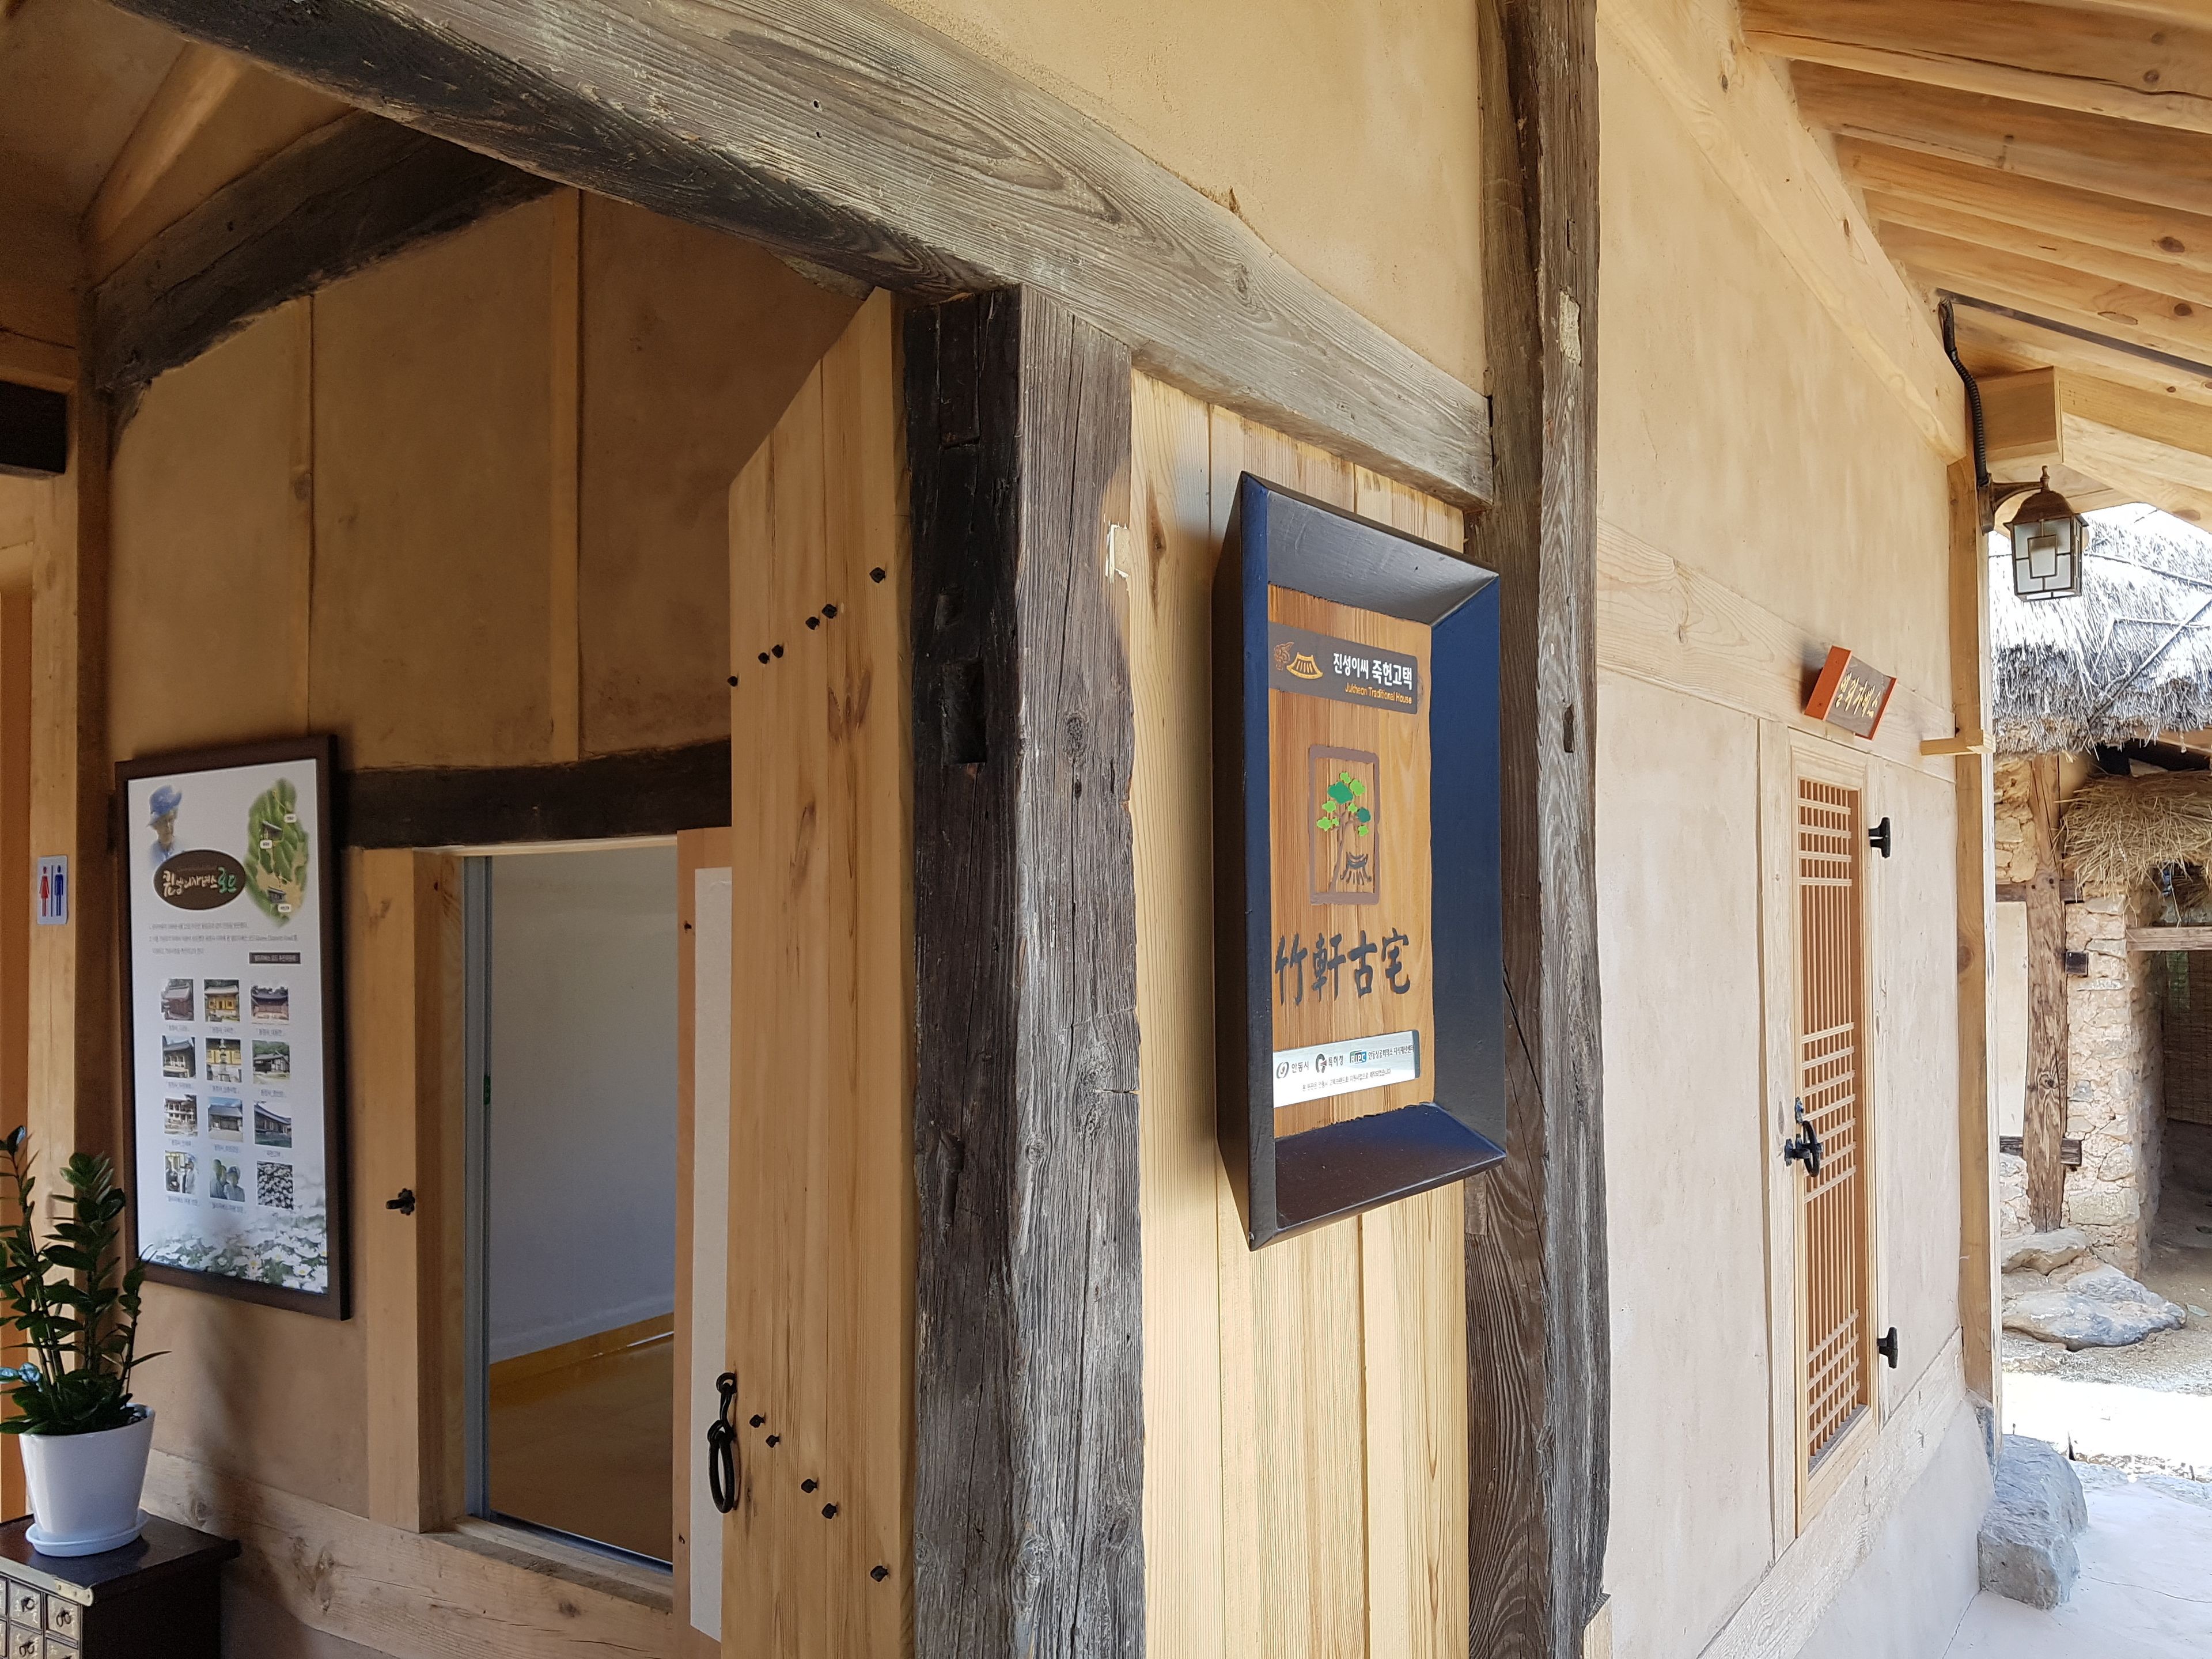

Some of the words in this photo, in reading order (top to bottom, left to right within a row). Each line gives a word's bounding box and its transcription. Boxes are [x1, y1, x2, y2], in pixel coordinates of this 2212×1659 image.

[1333, 653, 1369, 680] 진성이씨
[1372, 660, 1412, 691] 죽헌고택
[1368, 686, 1395, 701] Traditional
[1396, 692, 1412, 704] House
[1275, 927, 1411, 1006] 竹軒古宅
[1328, 1055, 1343, 1067] 특허청
[1350, 1051, 1367, 1065] RIPC
[1368, 1048, 1393, 1060] 안동상공회의소
[1291, 1060, 1309, 1073] 안동시
